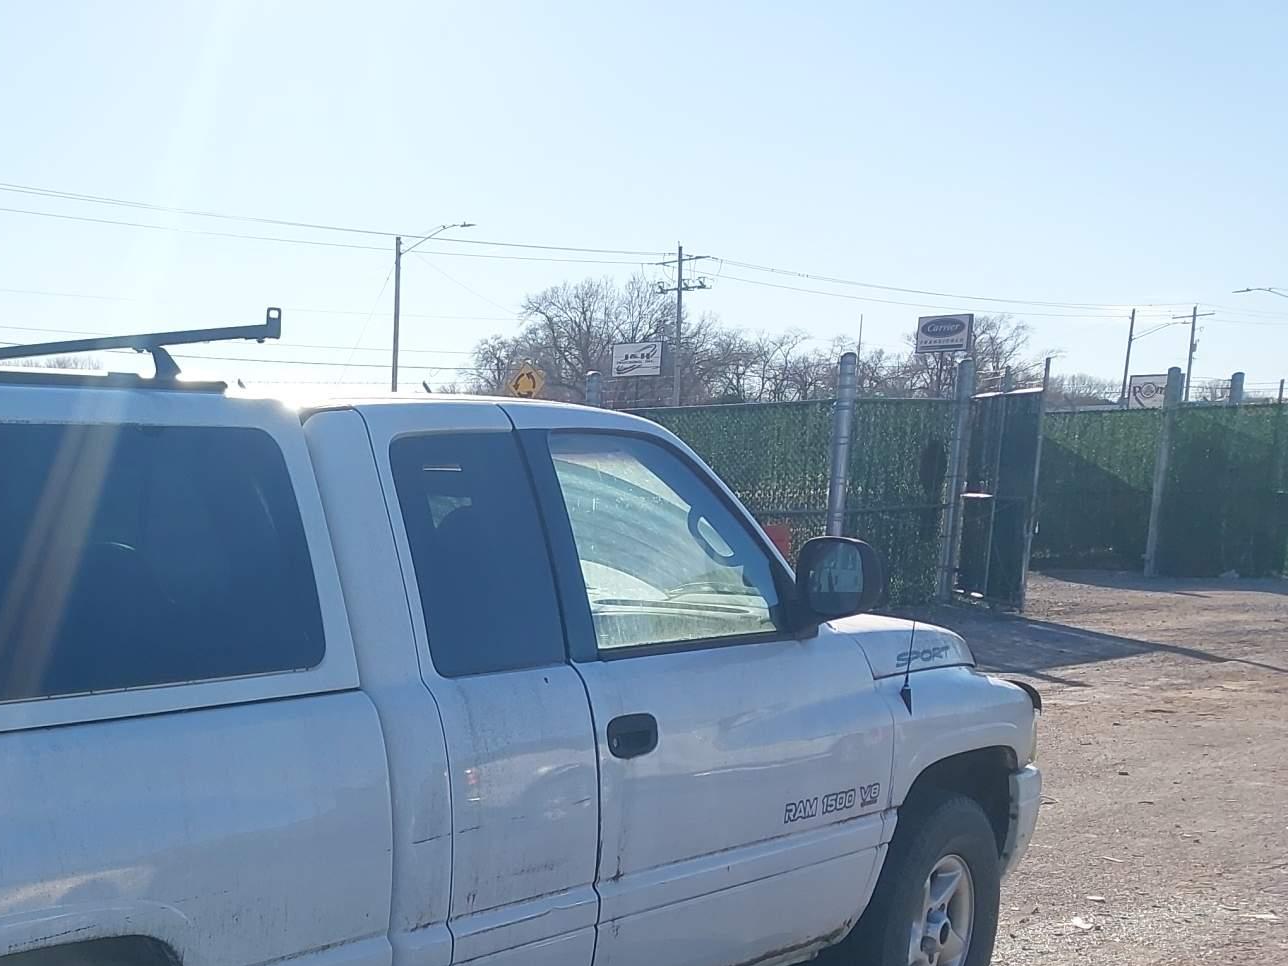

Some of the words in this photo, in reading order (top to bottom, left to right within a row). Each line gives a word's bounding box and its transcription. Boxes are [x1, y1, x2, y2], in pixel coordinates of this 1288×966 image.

[927, 322, 961, 332] Carrier
[895, 645, 950, 668] SPORT
[784, 797, 818, 824] RAM
[822, 788, 856, 815] 1500
[860, 783, 880, 801] V8
